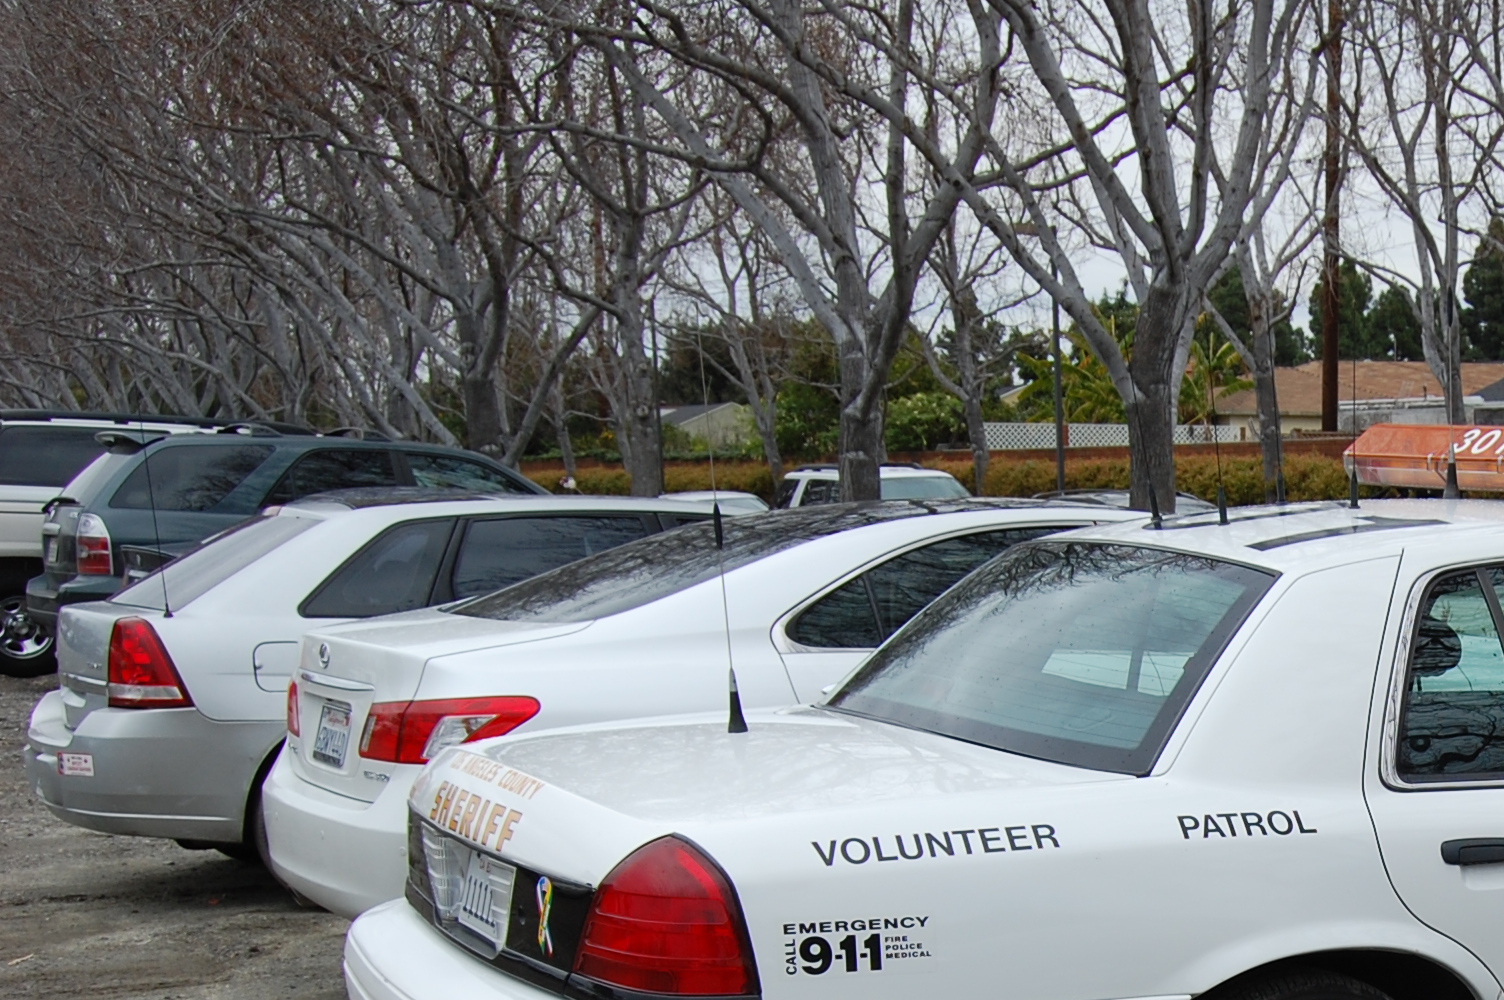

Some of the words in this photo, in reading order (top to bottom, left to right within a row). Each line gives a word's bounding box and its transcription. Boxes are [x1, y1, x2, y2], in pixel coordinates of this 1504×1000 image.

[498, 769, 546, 800] COUNTY
[430, 780, 523, 852] SHERIFF
[1177, 810, 1318, 840] PATROL
[811, 824, 1061, 867] VOLUNTEER
[783, 916, 929, 935] EMERGENCY
[785, 938, 797, 976] CALL
[799, 933, 882, 976] 9-1-1
[885, 943, 923, 951] POLICE
[885, 951, 932, 959] MEDICAL
